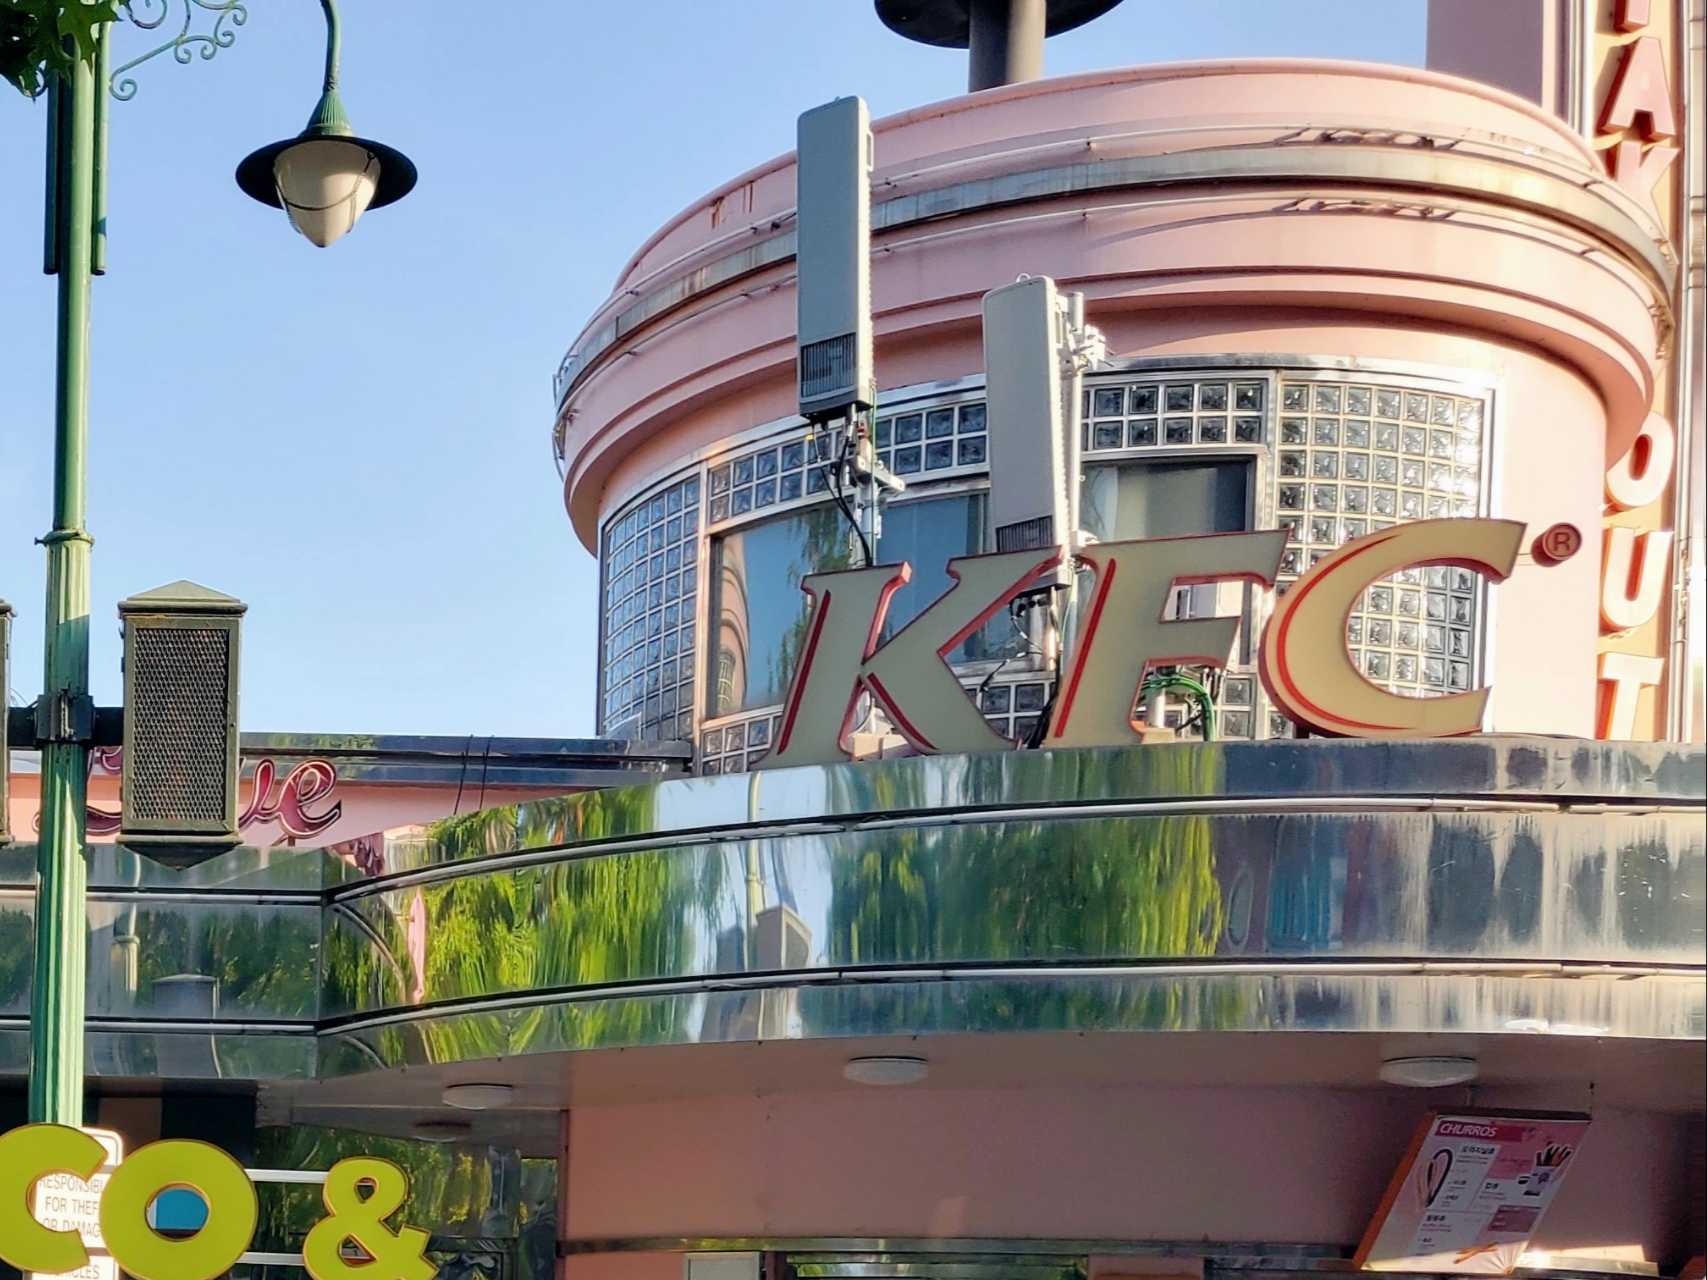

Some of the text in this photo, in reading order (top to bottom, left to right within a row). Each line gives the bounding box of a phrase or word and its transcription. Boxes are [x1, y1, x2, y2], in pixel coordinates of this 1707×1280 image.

[1597, 409, 1675, 742] OUT
[753, 518, 1527, 772] KFC
[1440, 1123, 1499, 1138] CHURROS
[38, 1174, 104, 1194] RESPONSIBL
[45, 1196, 99, 1216] FOR THEF
[43, 1217, 101, 1238] OR DAMAG
